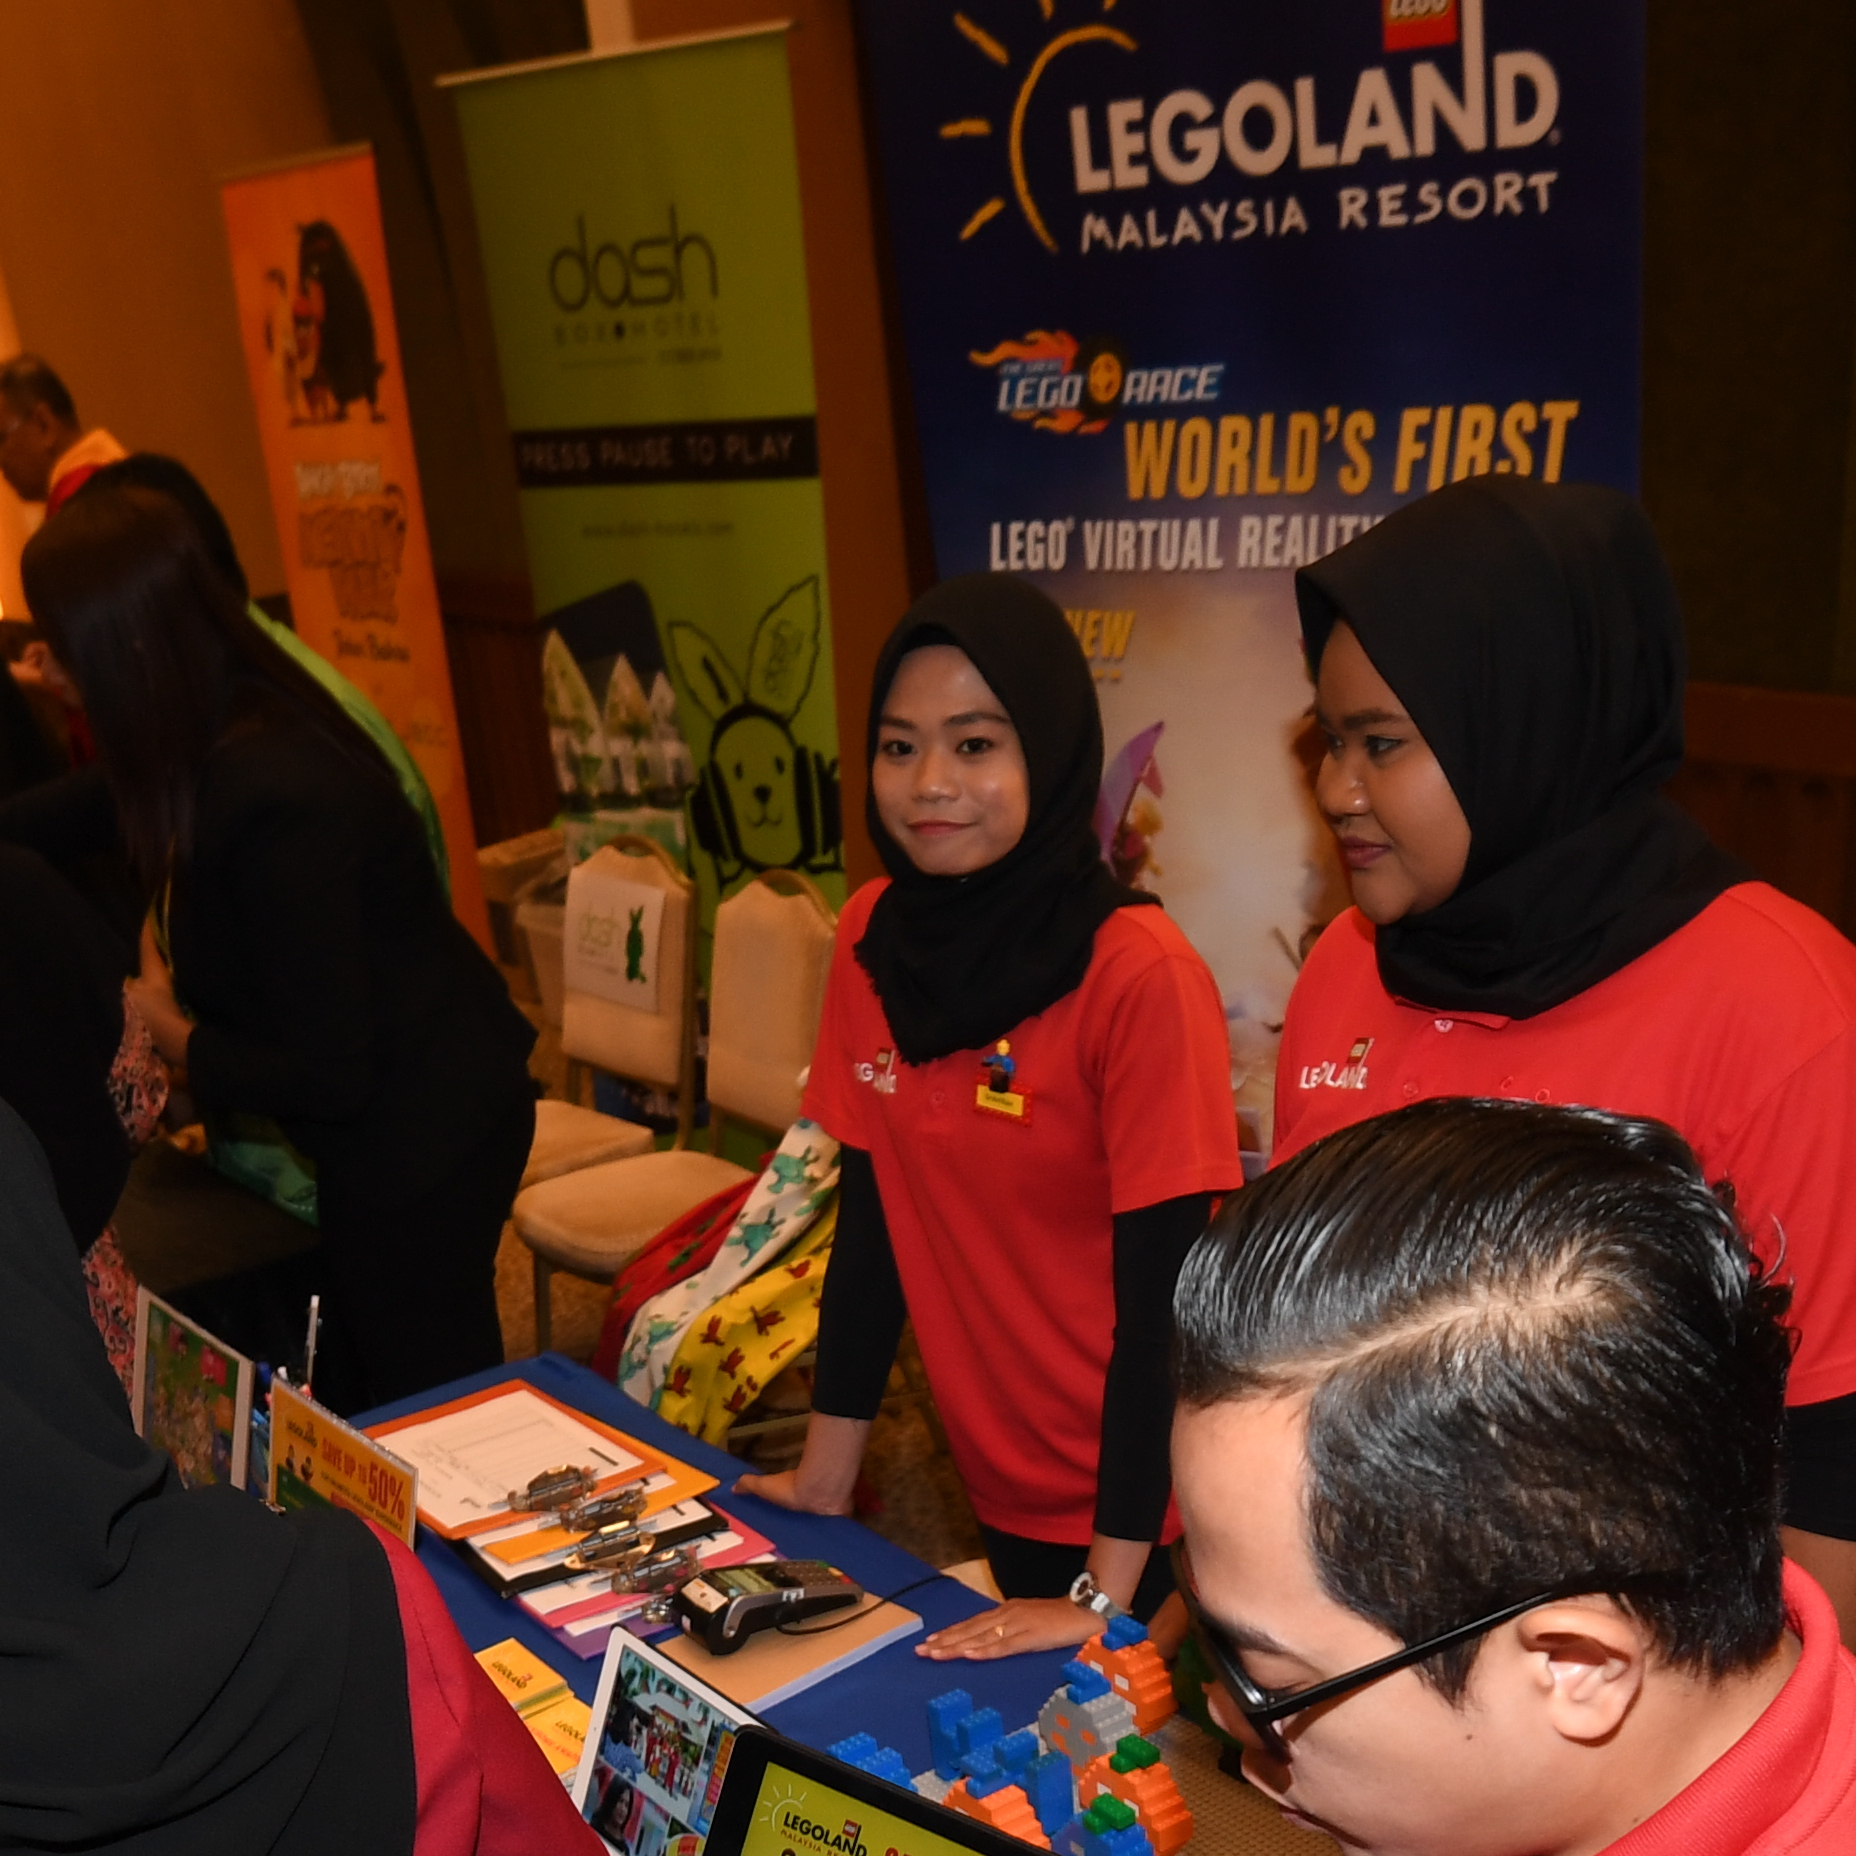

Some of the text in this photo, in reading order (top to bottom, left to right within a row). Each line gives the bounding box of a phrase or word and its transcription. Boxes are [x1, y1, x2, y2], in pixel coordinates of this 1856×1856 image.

[1080, 171, 1559, 254] MALAYSIA RESORT
[997, 363, 1226, 412] LEGO RACE
[520, 433, 796, 475] PRESS PAUSE TO PLAY
[1122, 398, 1580, 500] WORLD'S FIRST
[990, 521, 1067, 573] LEGO
[1083, 515, 1225, 572] VIRTUAL
[367, 1460, 406, 1522] 50%
